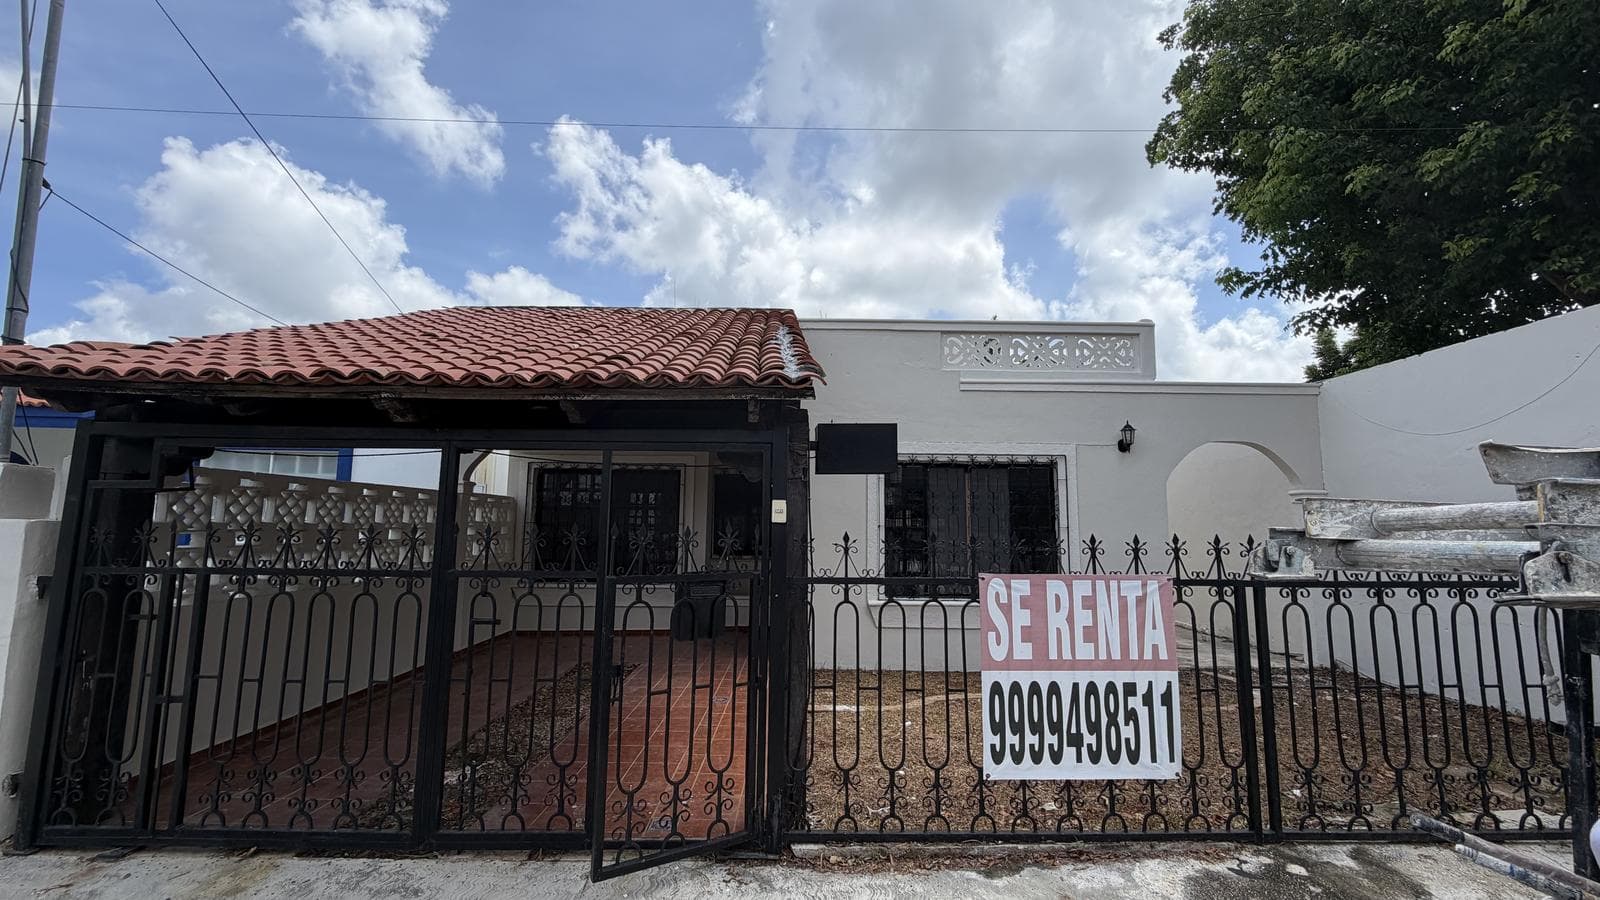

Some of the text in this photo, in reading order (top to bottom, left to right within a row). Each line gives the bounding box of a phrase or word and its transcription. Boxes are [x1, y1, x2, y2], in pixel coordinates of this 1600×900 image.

[987, 578, 1168, 661] SE RENTA
[989, 680, 1175, 765] 9999498511
